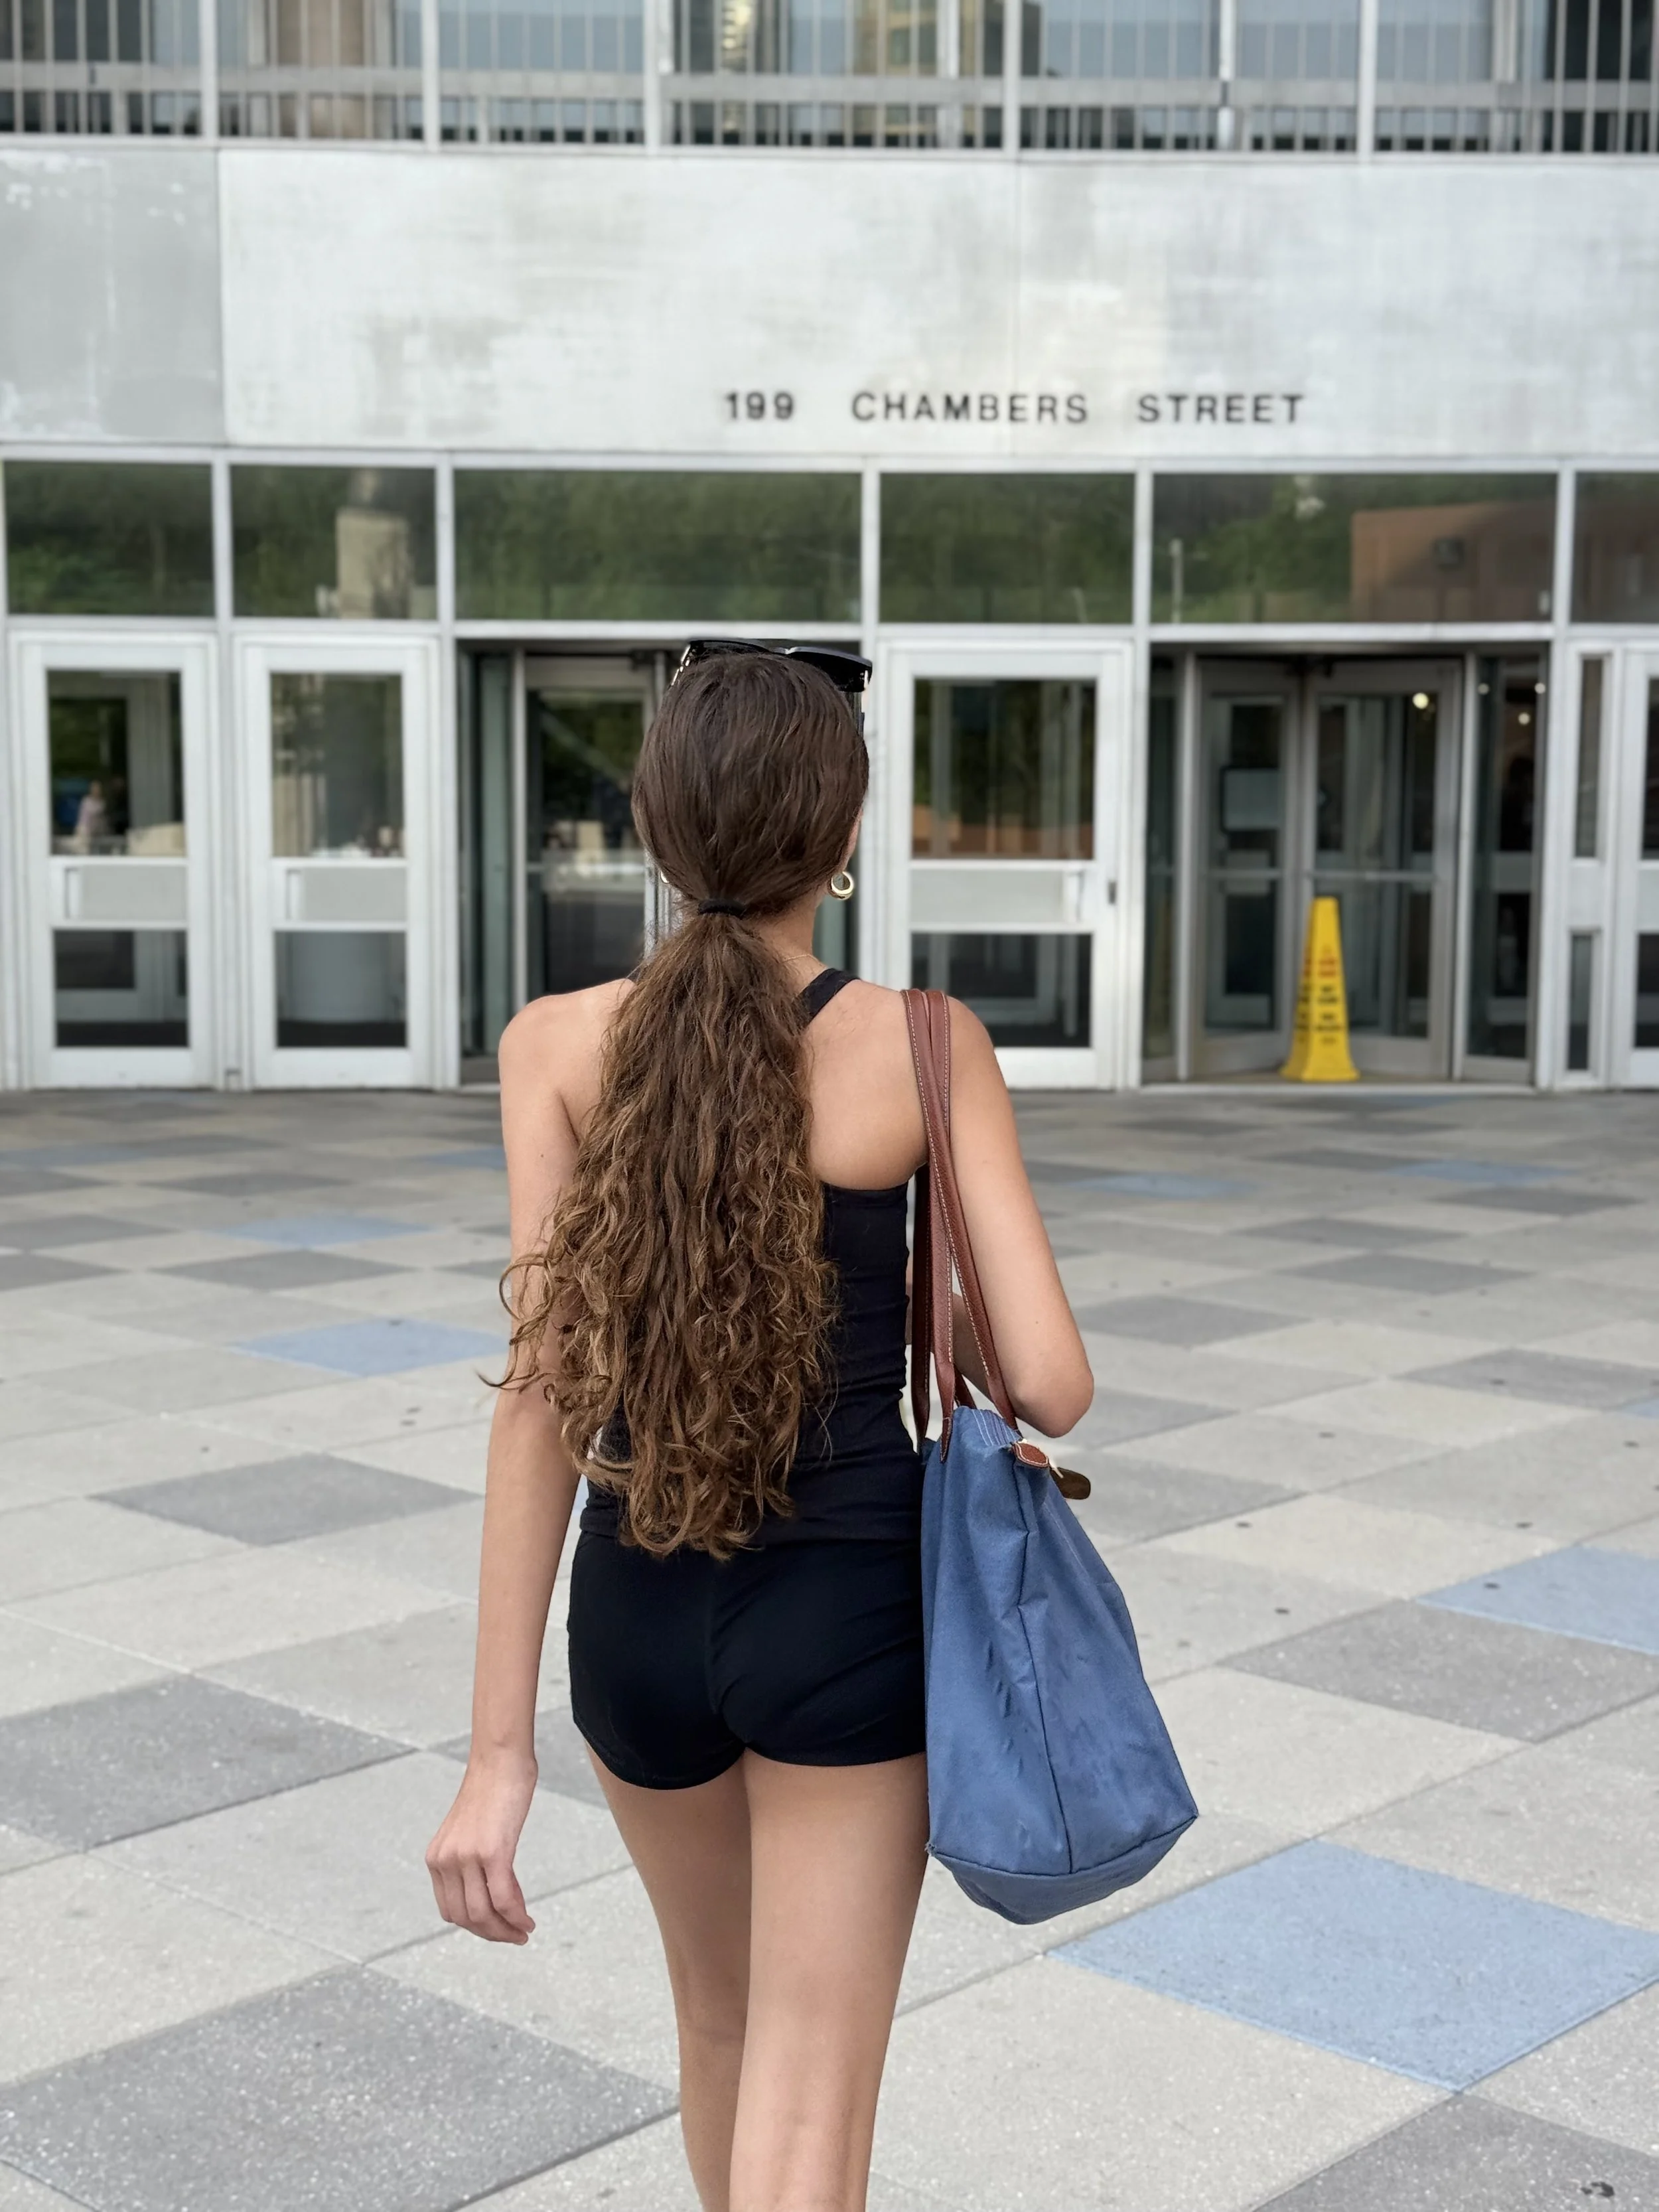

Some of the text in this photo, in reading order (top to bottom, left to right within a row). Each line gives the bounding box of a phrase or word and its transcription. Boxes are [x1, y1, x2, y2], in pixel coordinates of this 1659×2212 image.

[726, 392, 1304, 424] 199 CHAMBERS STREET
